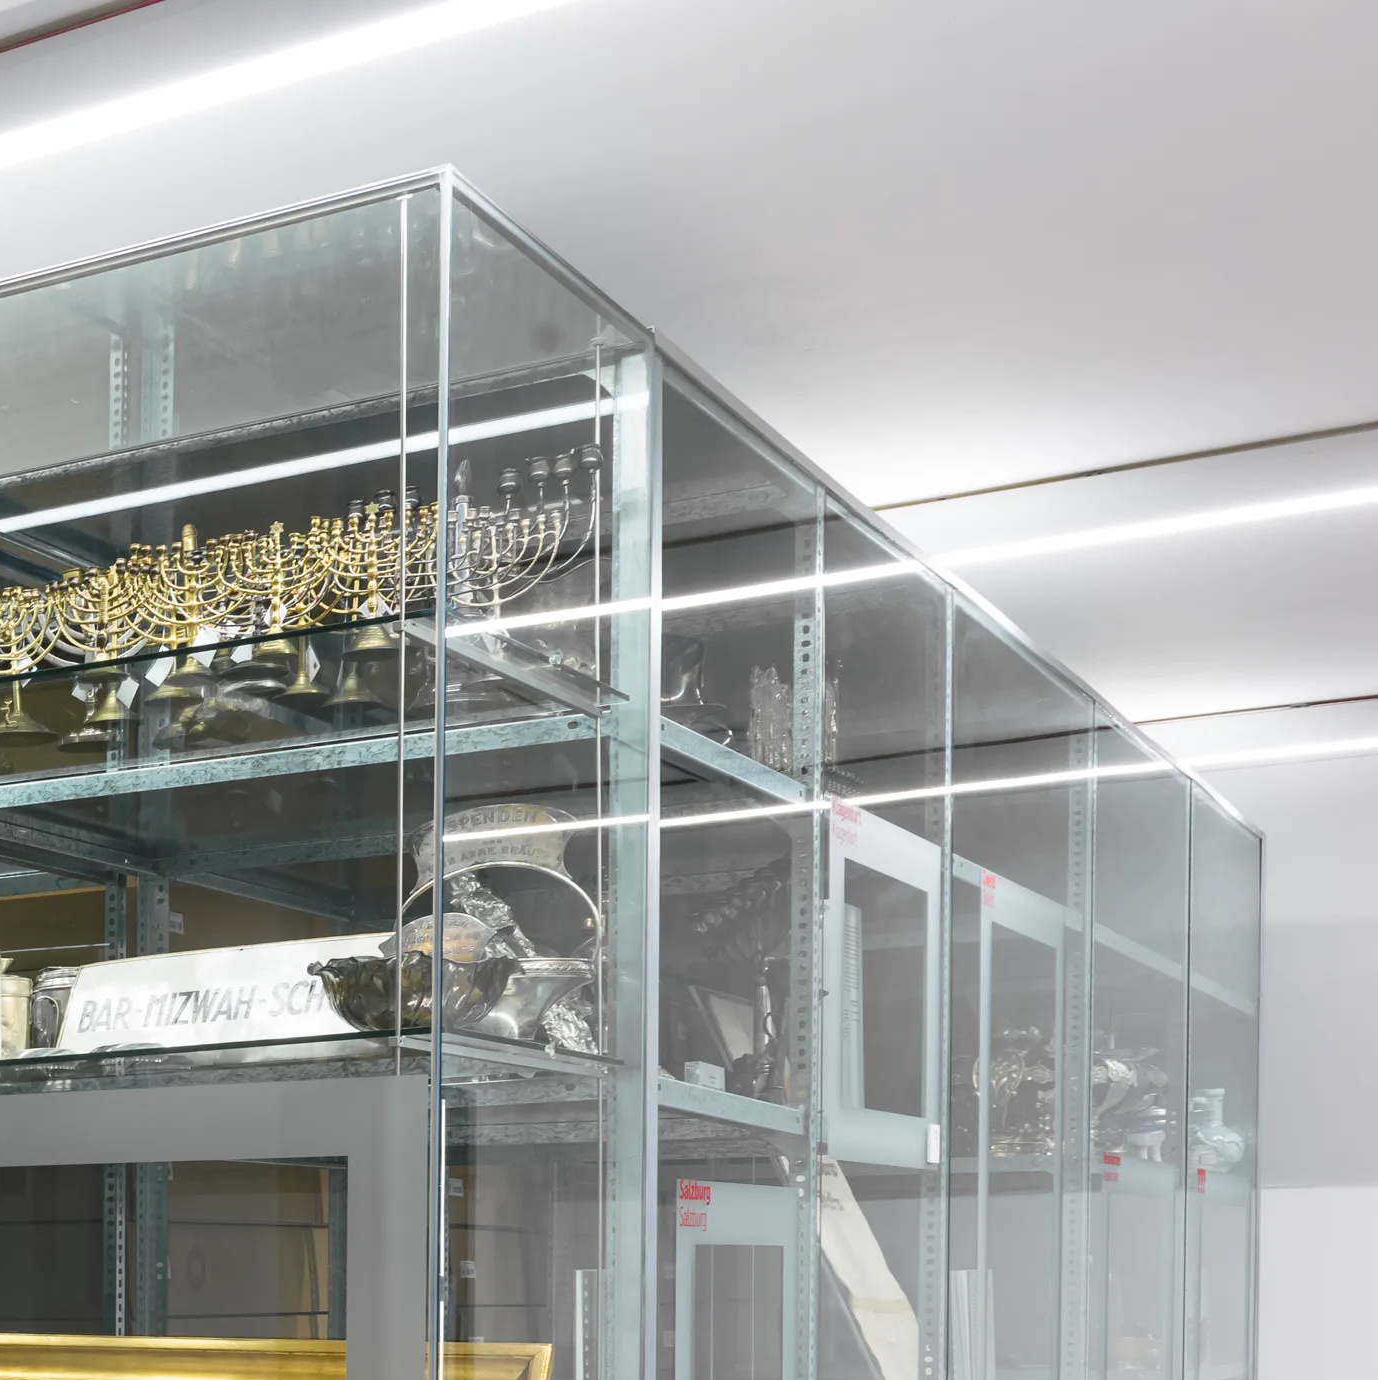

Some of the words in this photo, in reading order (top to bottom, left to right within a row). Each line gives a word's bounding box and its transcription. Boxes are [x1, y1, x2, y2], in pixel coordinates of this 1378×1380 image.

[444, 808, 538, 834] SPENDEN
[679, 1179, 712, 1206] Salzburg
[679, 1206, 707, 1232] Salzburg
